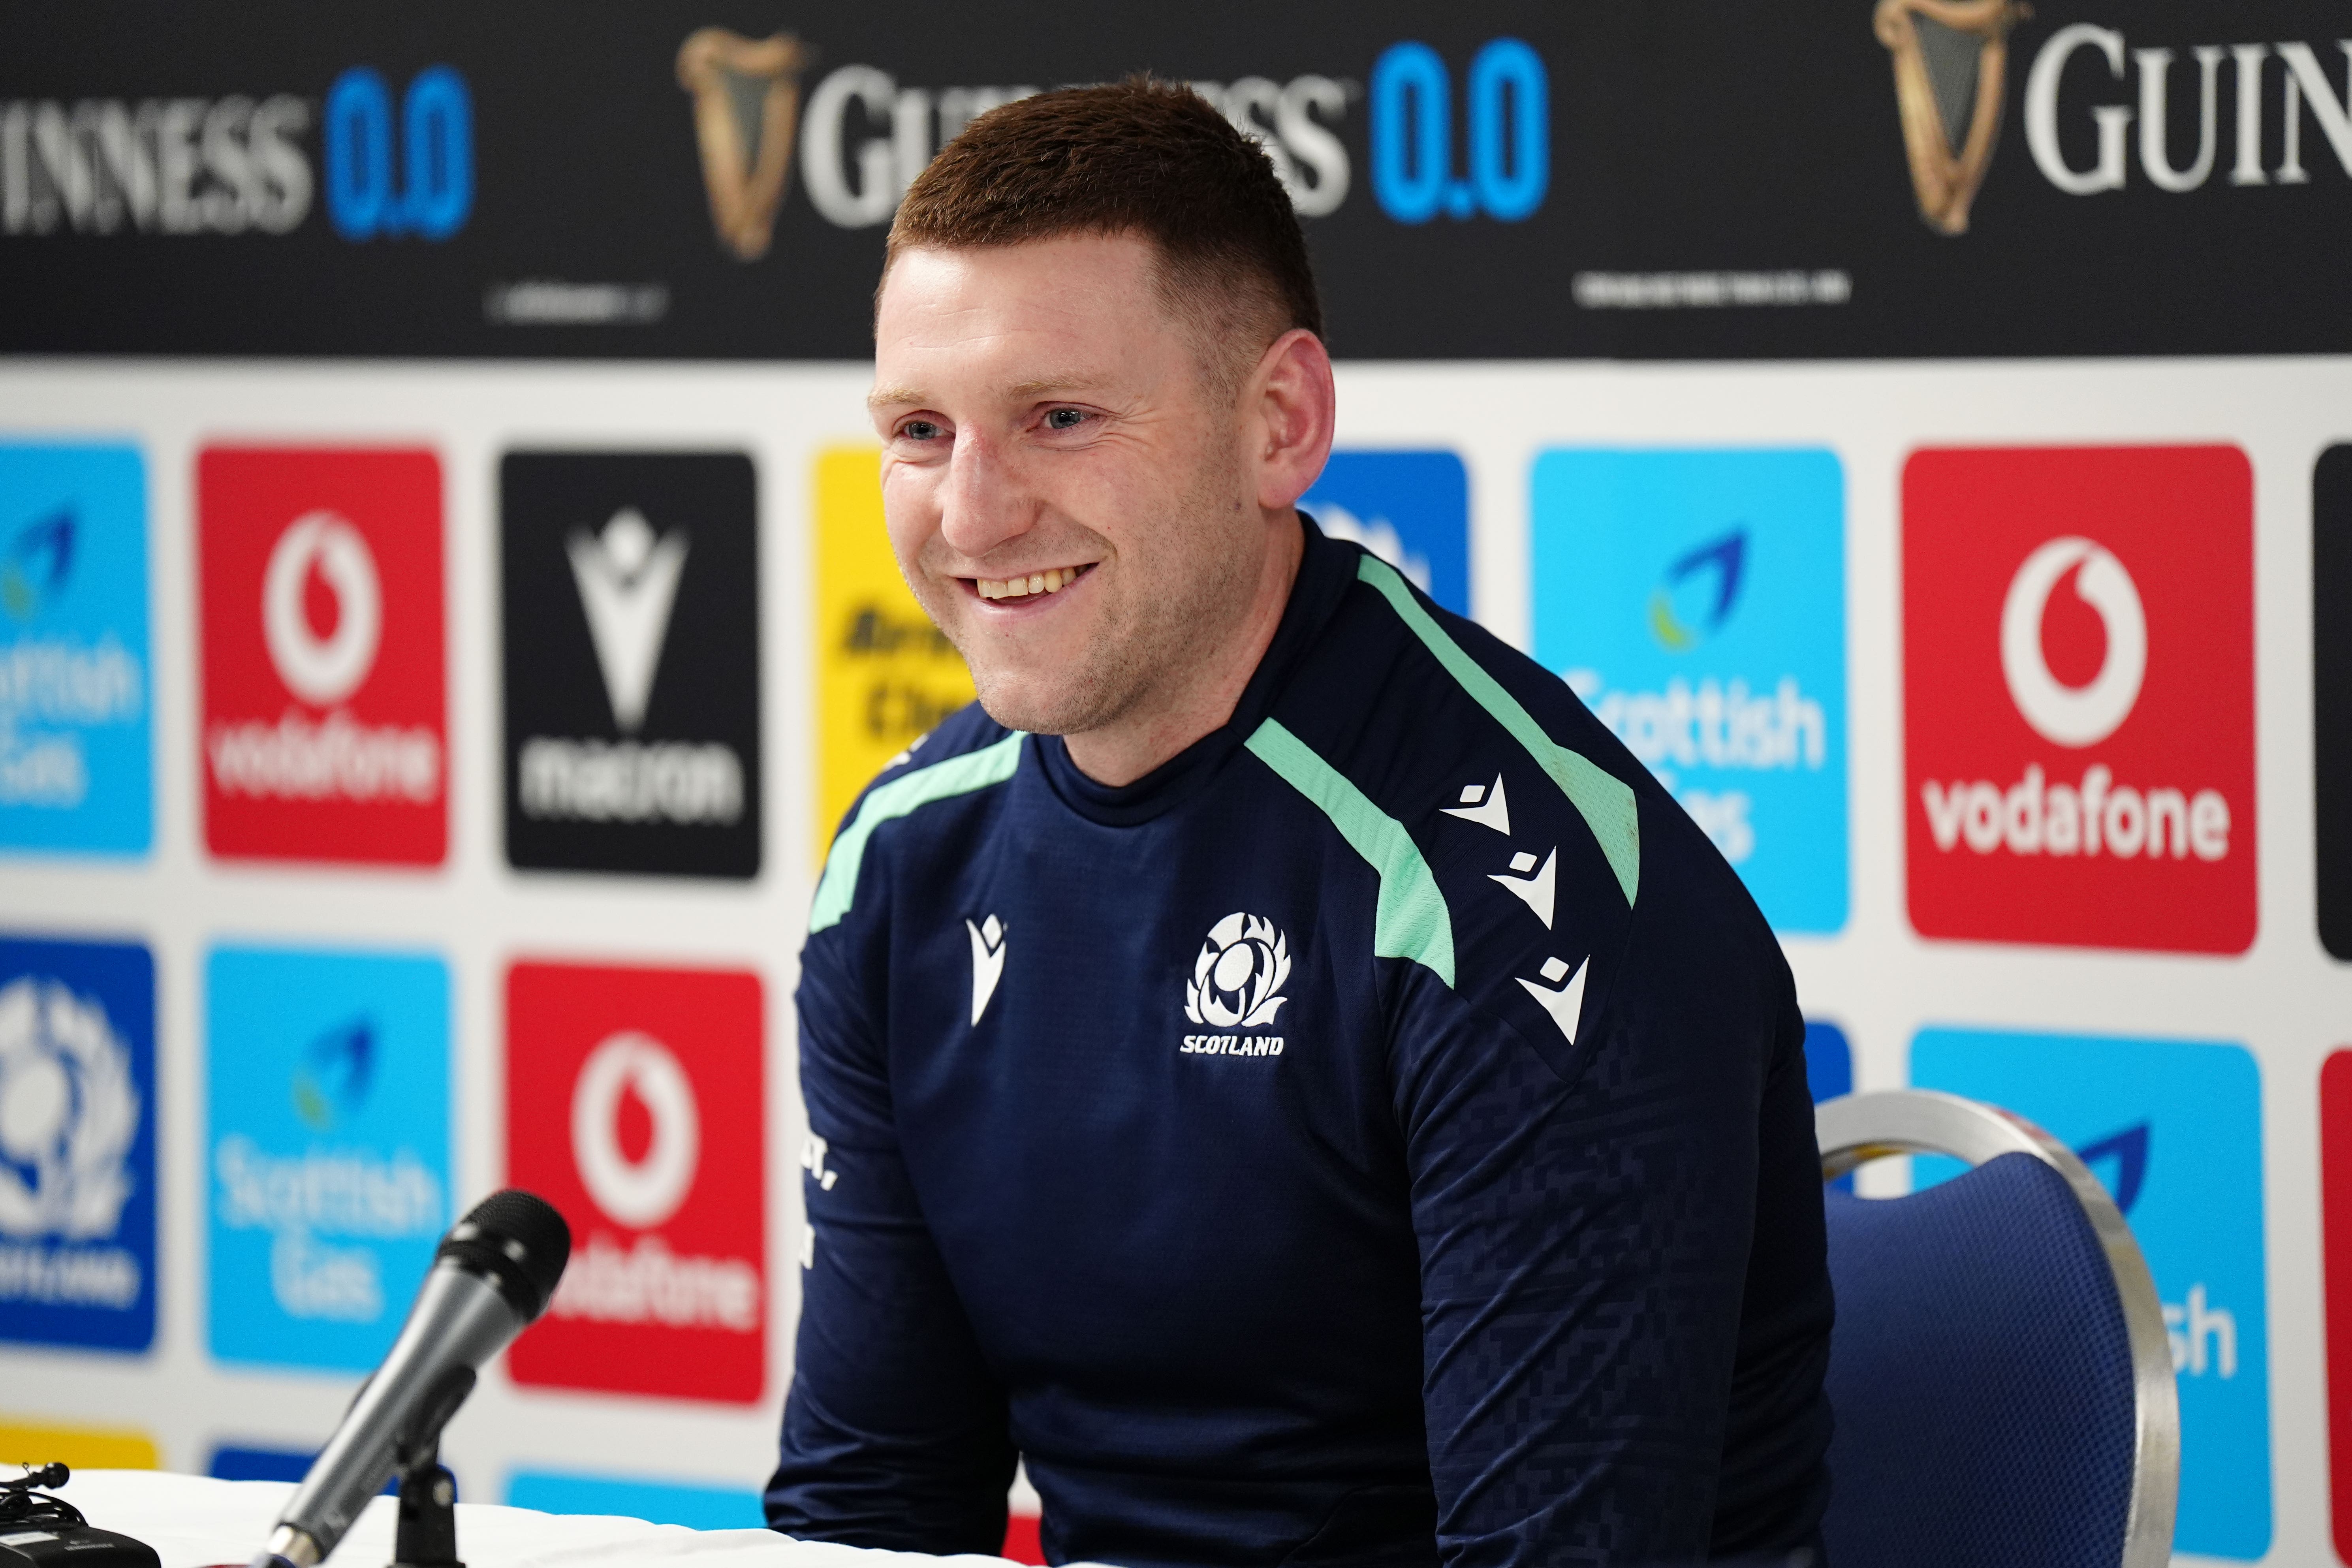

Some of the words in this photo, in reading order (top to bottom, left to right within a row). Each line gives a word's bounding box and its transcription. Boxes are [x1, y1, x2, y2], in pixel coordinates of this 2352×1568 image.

[327, 66, 473, 240] 0.0
[1371, 39, 1549, 222] 0.0
[519, 735, 745, 825] macron
[1921, 762, 2231, 861] vodafone
[1180, 1035, 1284, 1056] SCOTLAND
